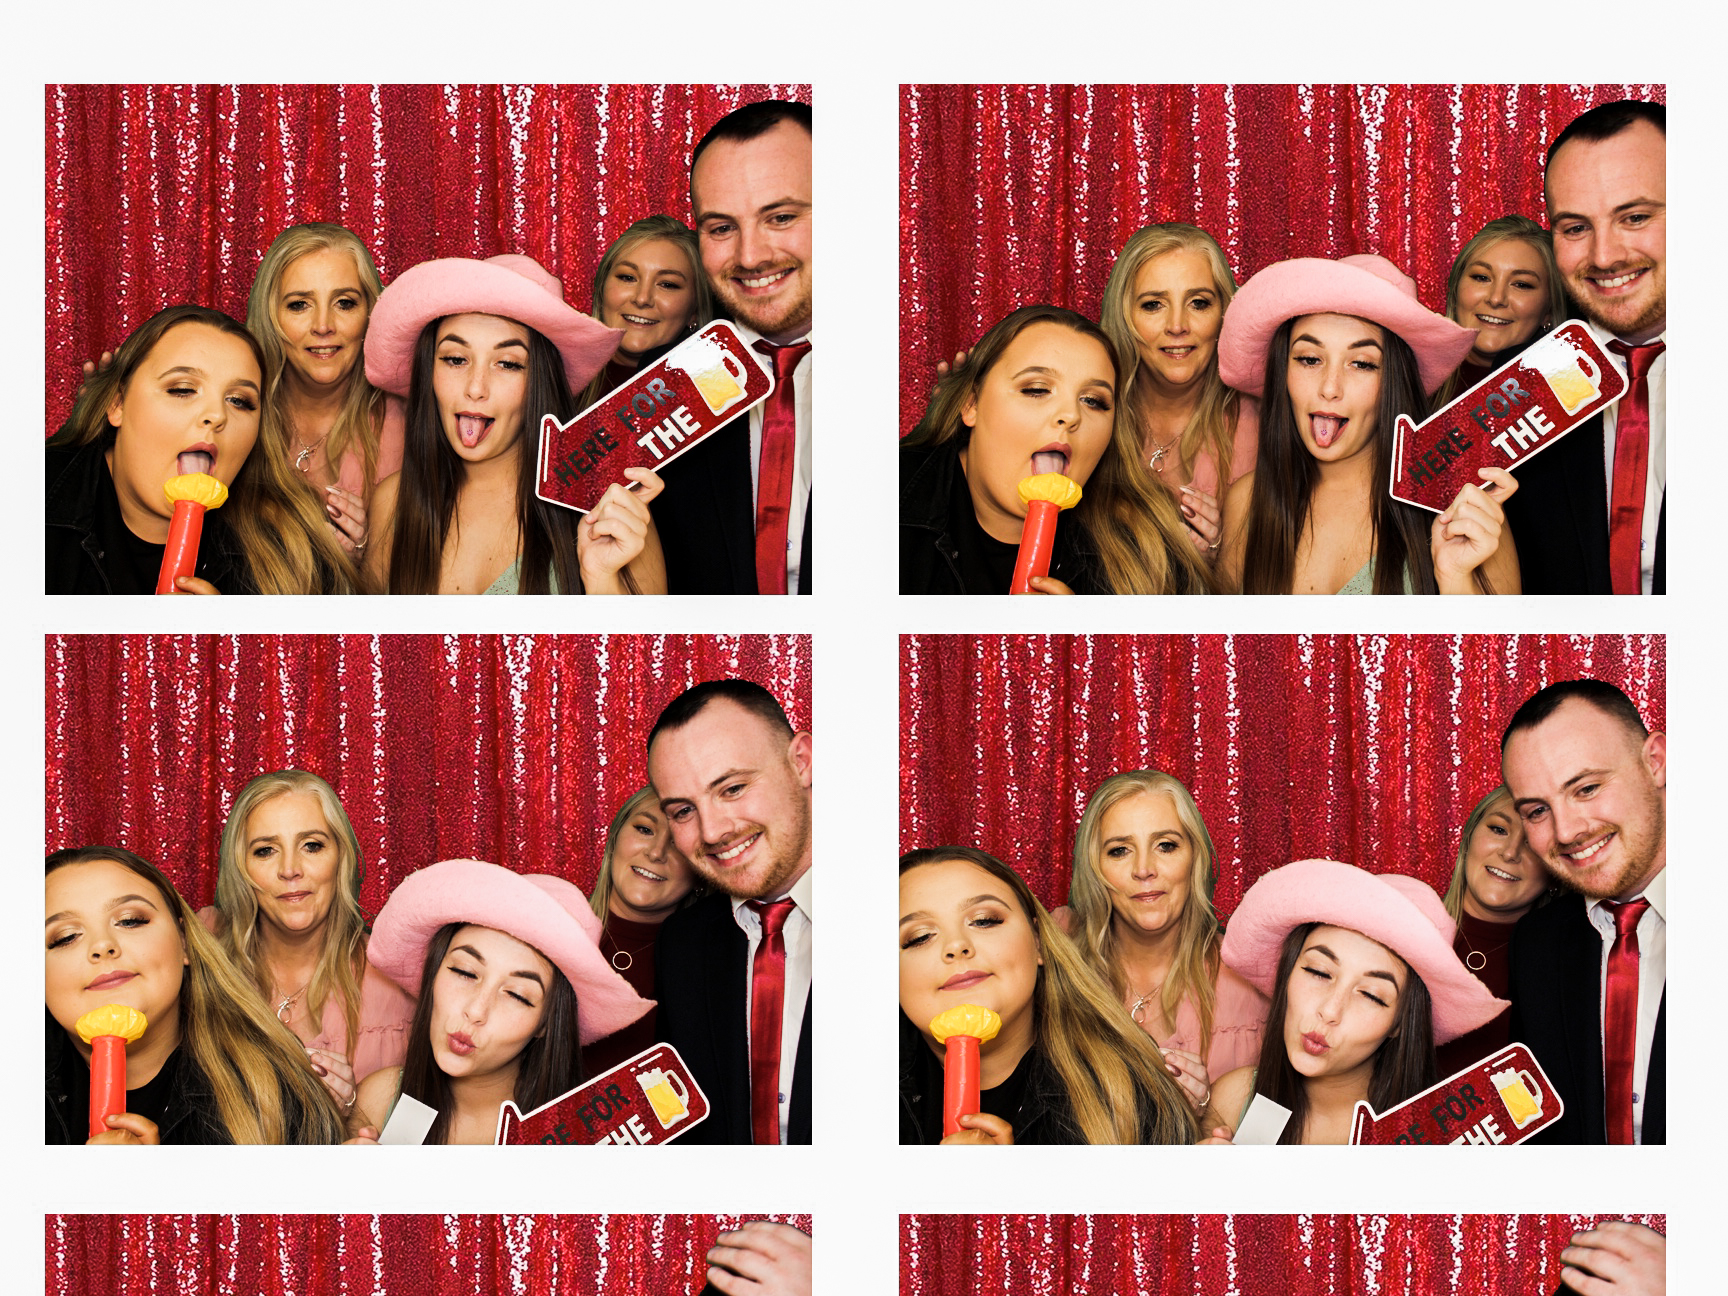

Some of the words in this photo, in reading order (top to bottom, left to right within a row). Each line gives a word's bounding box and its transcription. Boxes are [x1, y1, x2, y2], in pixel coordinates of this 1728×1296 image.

[554, 427, 618, 487] HERE
[615, 377, 676, 432] FOR
[636, 405, 701, 460] THE
[1407, 427, 1473, 487] HERE
[1469, 377, 1530, 432] FOR
[1490, 405, 1555, 460] THE
[576, 1083, 631, 1133] FOR
[1430, 1083, 1485, 1133] FOR
